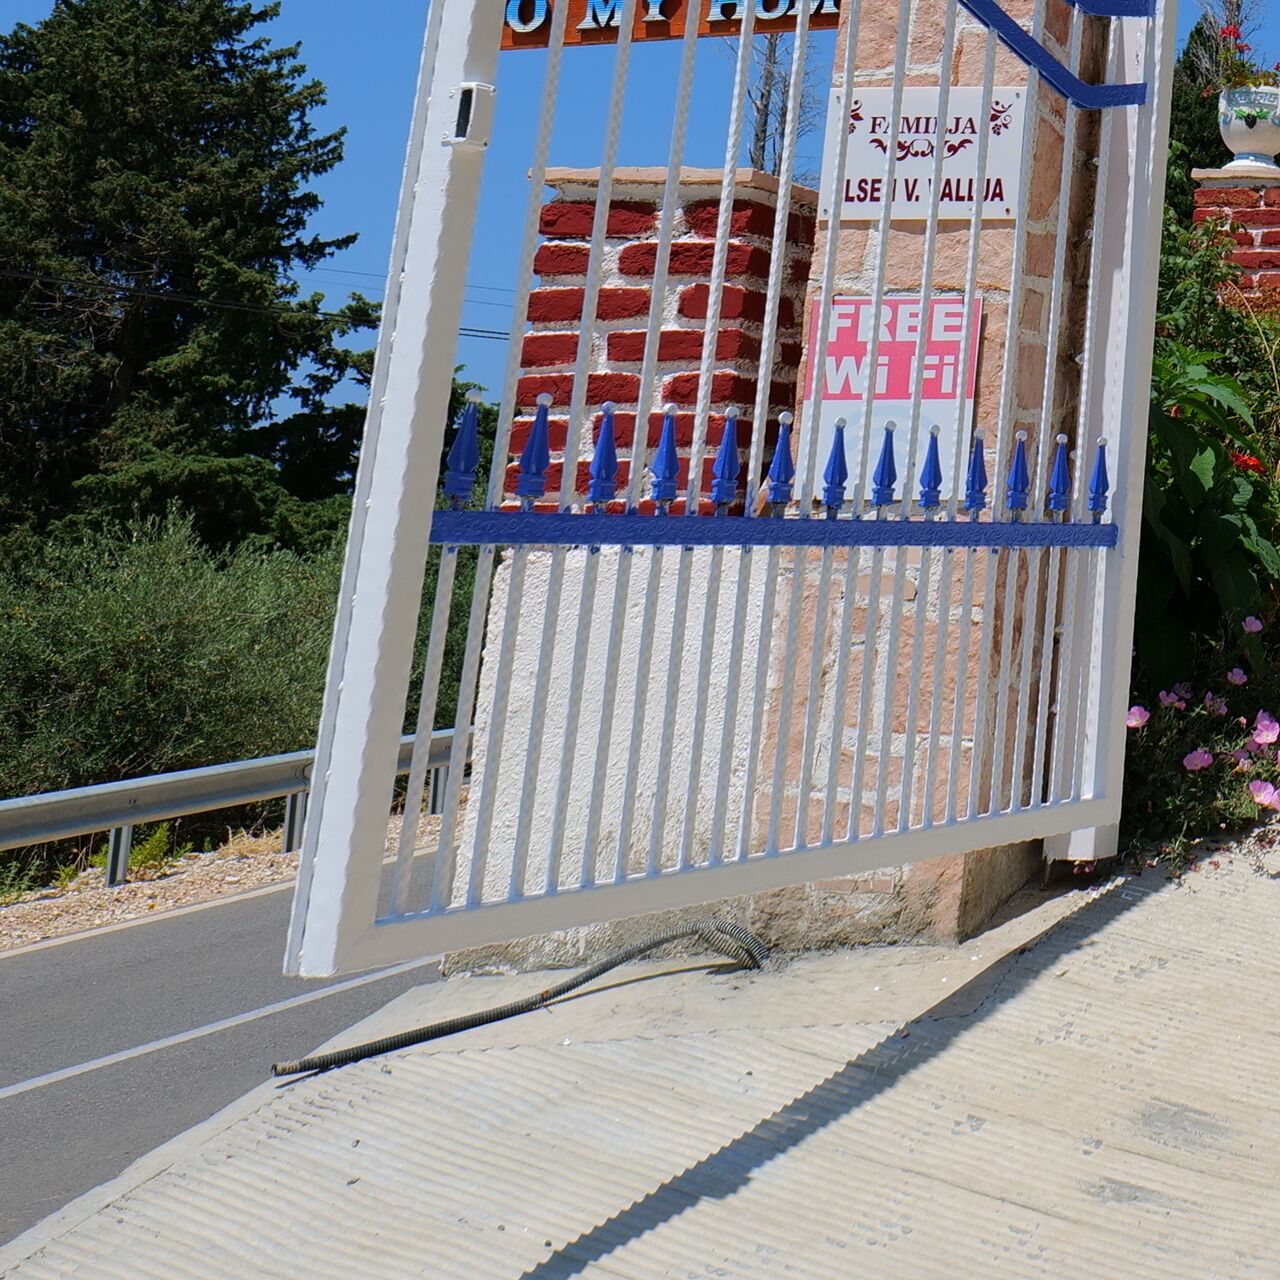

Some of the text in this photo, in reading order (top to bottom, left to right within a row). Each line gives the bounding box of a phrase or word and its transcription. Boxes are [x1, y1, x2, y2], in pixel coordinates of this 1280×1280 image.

[904, 178, 920, 202] V.
[928, 178, 1004, 202] ALLJA
[827, 303, 966, 342] FREE
